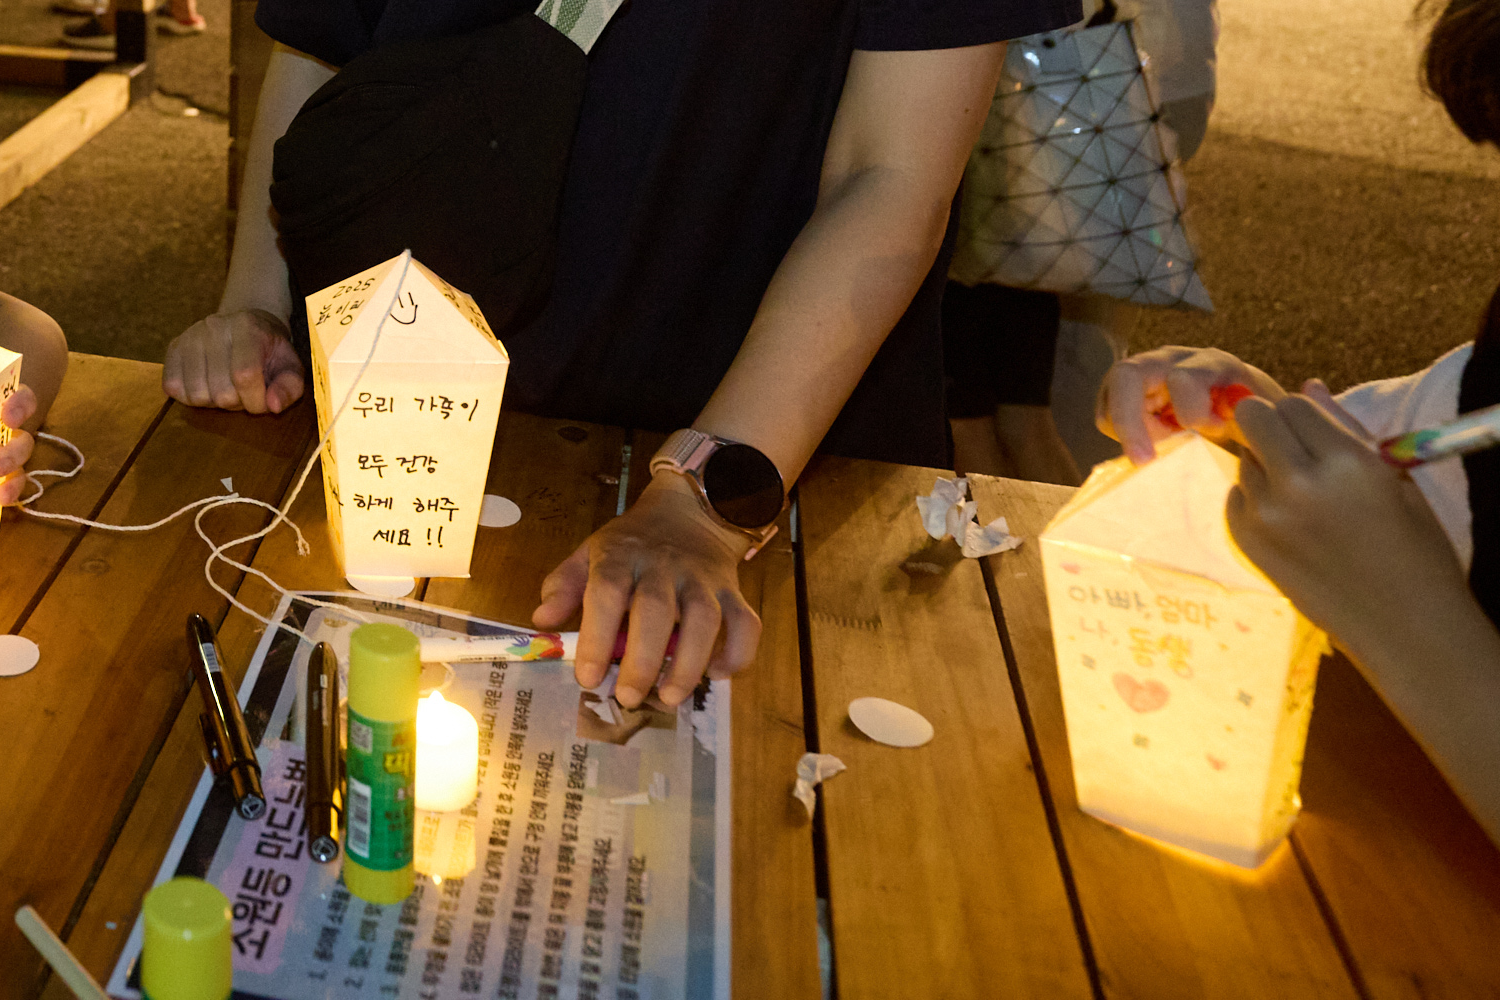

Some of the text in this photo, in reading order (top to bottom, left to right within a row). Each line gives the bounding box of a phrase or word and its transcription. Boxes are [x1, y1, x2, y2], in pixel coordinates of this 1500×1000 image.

[332, 277, 376, 299] 2025
[353, 392, 479, 422] 우리 가족이
[358, 454, 388, 478] 모두
[353, 493, 460, 522] 하게 해주
[373, 525, 444, 548] 세요 !!
[1155, 593, 1218, 631] 엄마
[497, 761, 521, 790] 소원등
[213, 864, 294, 960] 소원등
